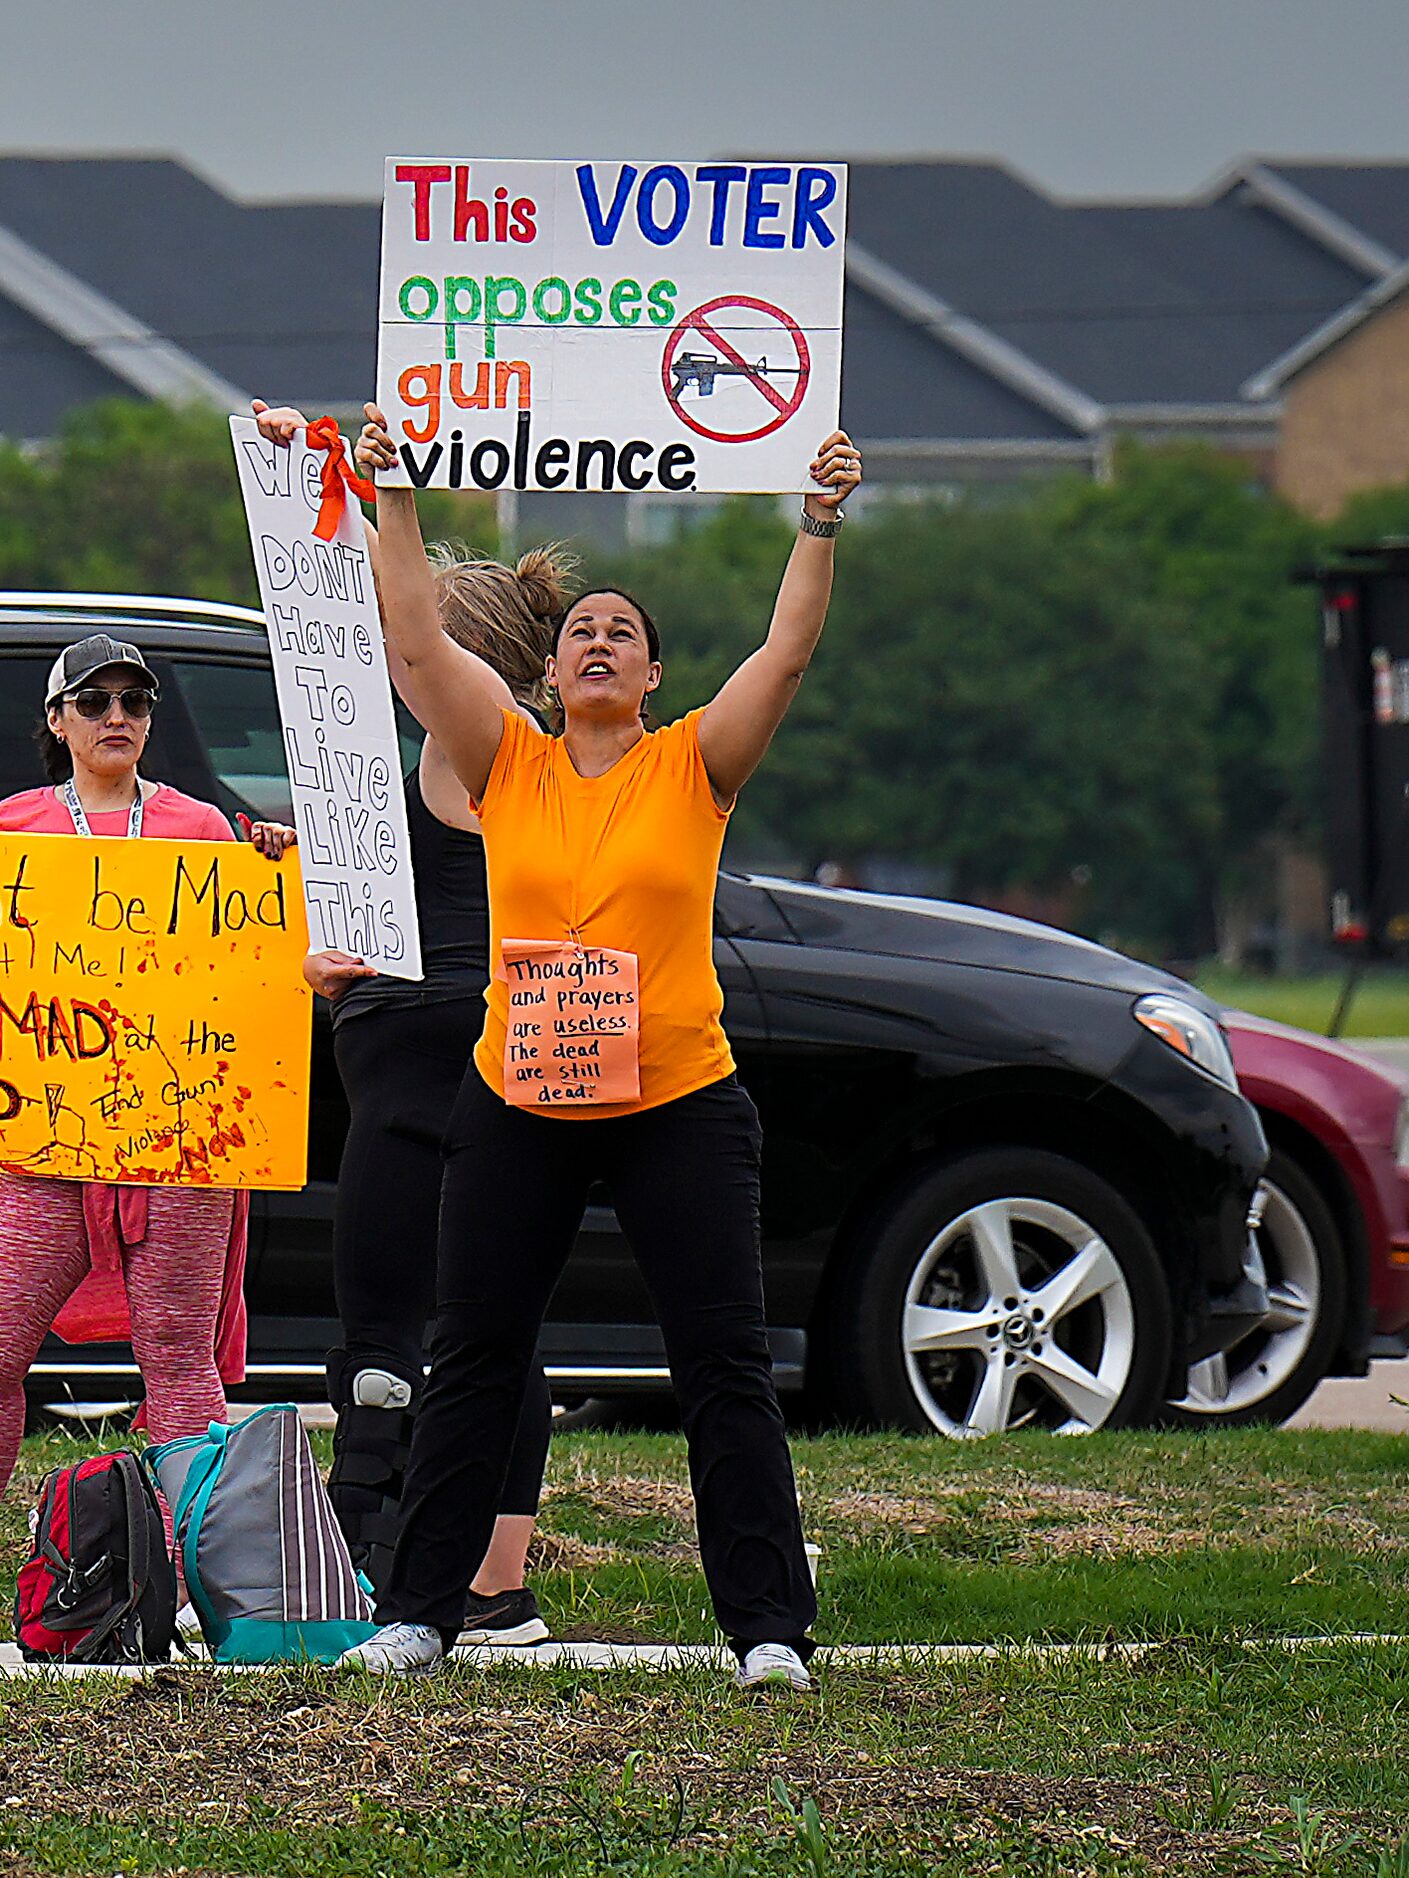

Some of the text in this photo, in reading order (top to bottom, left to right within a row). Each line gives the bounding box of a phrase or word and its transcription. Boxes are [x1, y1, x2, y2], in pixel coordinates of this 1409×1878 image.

[395, 164, 836, 249] This VOTER
[398, 275, 678, 359] opposes
[397, 359, 531, 443] gun
[242, 441, 322, 513] We
[399, 410, 697, 491] violence.
[261, 533, 365, 604] DONT
[273, 604, 373, 666] Have
[295, 666, 355, 726] To
[286, 727, 390, 812] Live
[88, 857, 152, 935] be
[167, 855, 286, 938] Mad
[307, 880, 405, 961] This
[507, 953, 619, 988] Thoughts
[511, 986, 635, 1011] and prayers
[125, 1015, 159, 1055] at
[181, 1020, 237, 1056] the
[509, 1039, 599, 1062] The dead
[513, 1014, 631, 1038] are useless.
[90, 1080, 217, 1118] End Gun
[516, 1063, 601, 1081] are still
